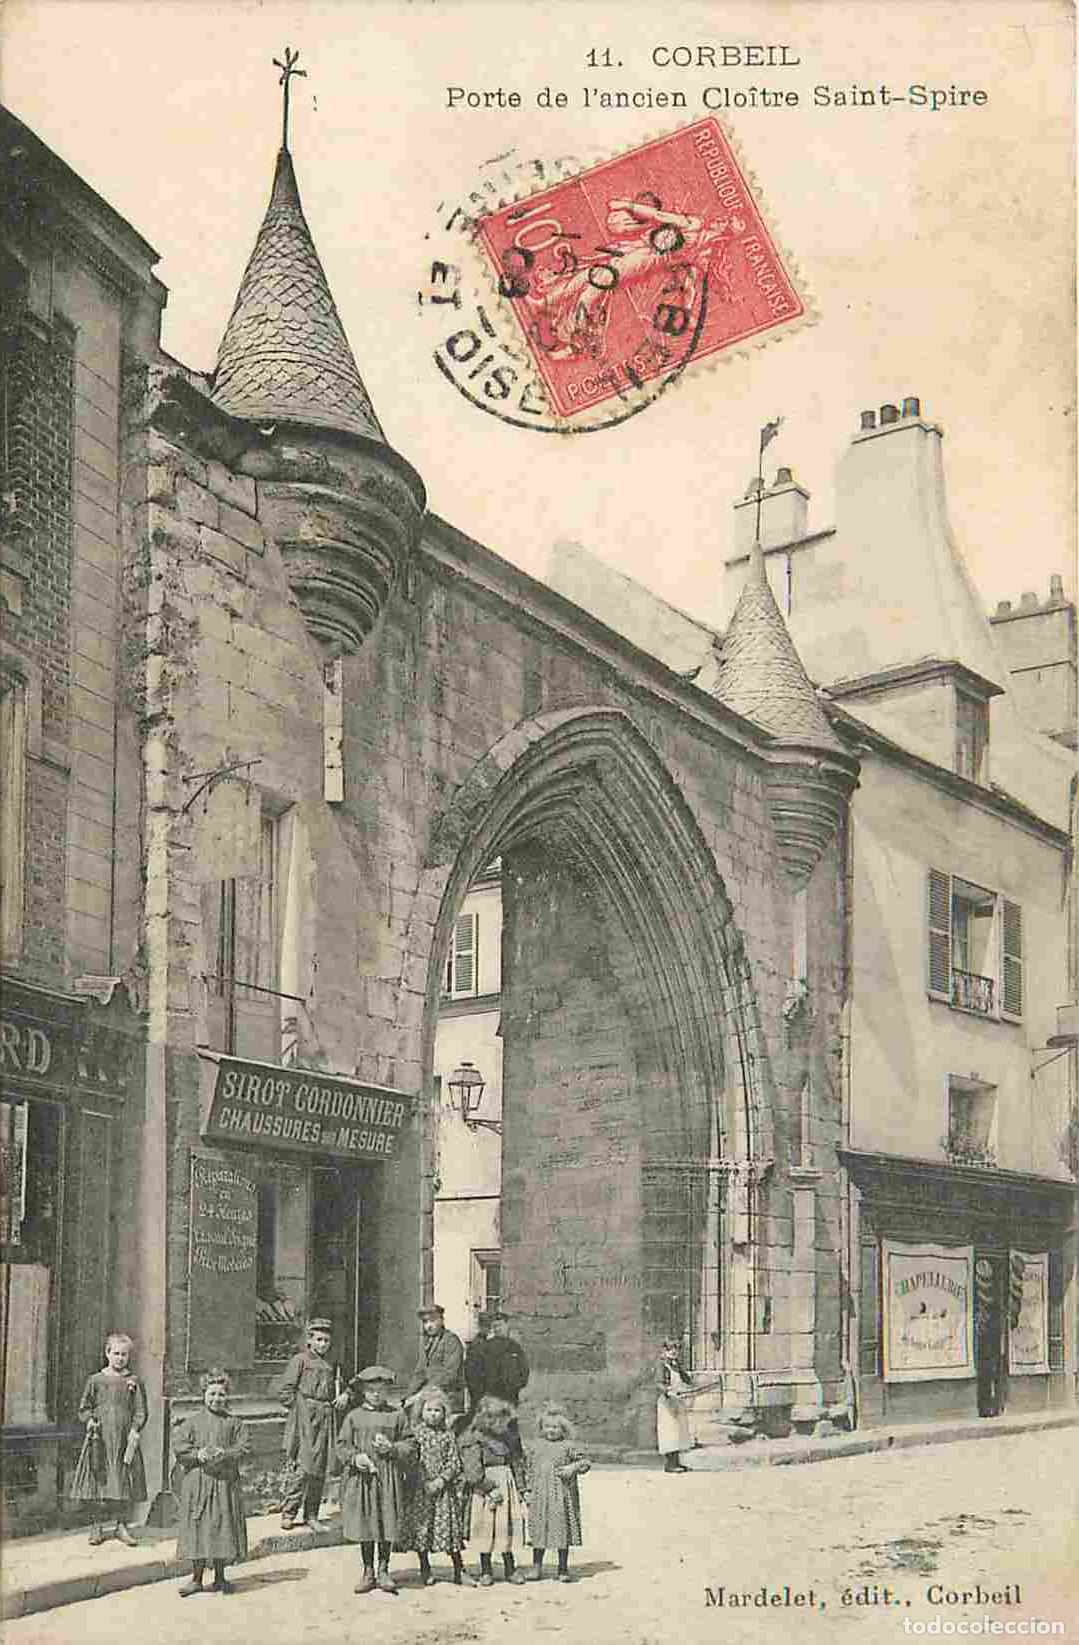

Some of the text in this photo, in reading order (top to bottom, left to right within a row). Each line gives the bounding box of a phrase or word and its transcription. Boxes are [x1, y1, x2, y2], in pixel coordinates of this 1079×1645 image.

[222, 1071, 405, 1128] SIROT CORDONNIER
[219, 1107, 322, 1143] CHAUSSURES
[336, 1127, 396, 1154] MESURE
